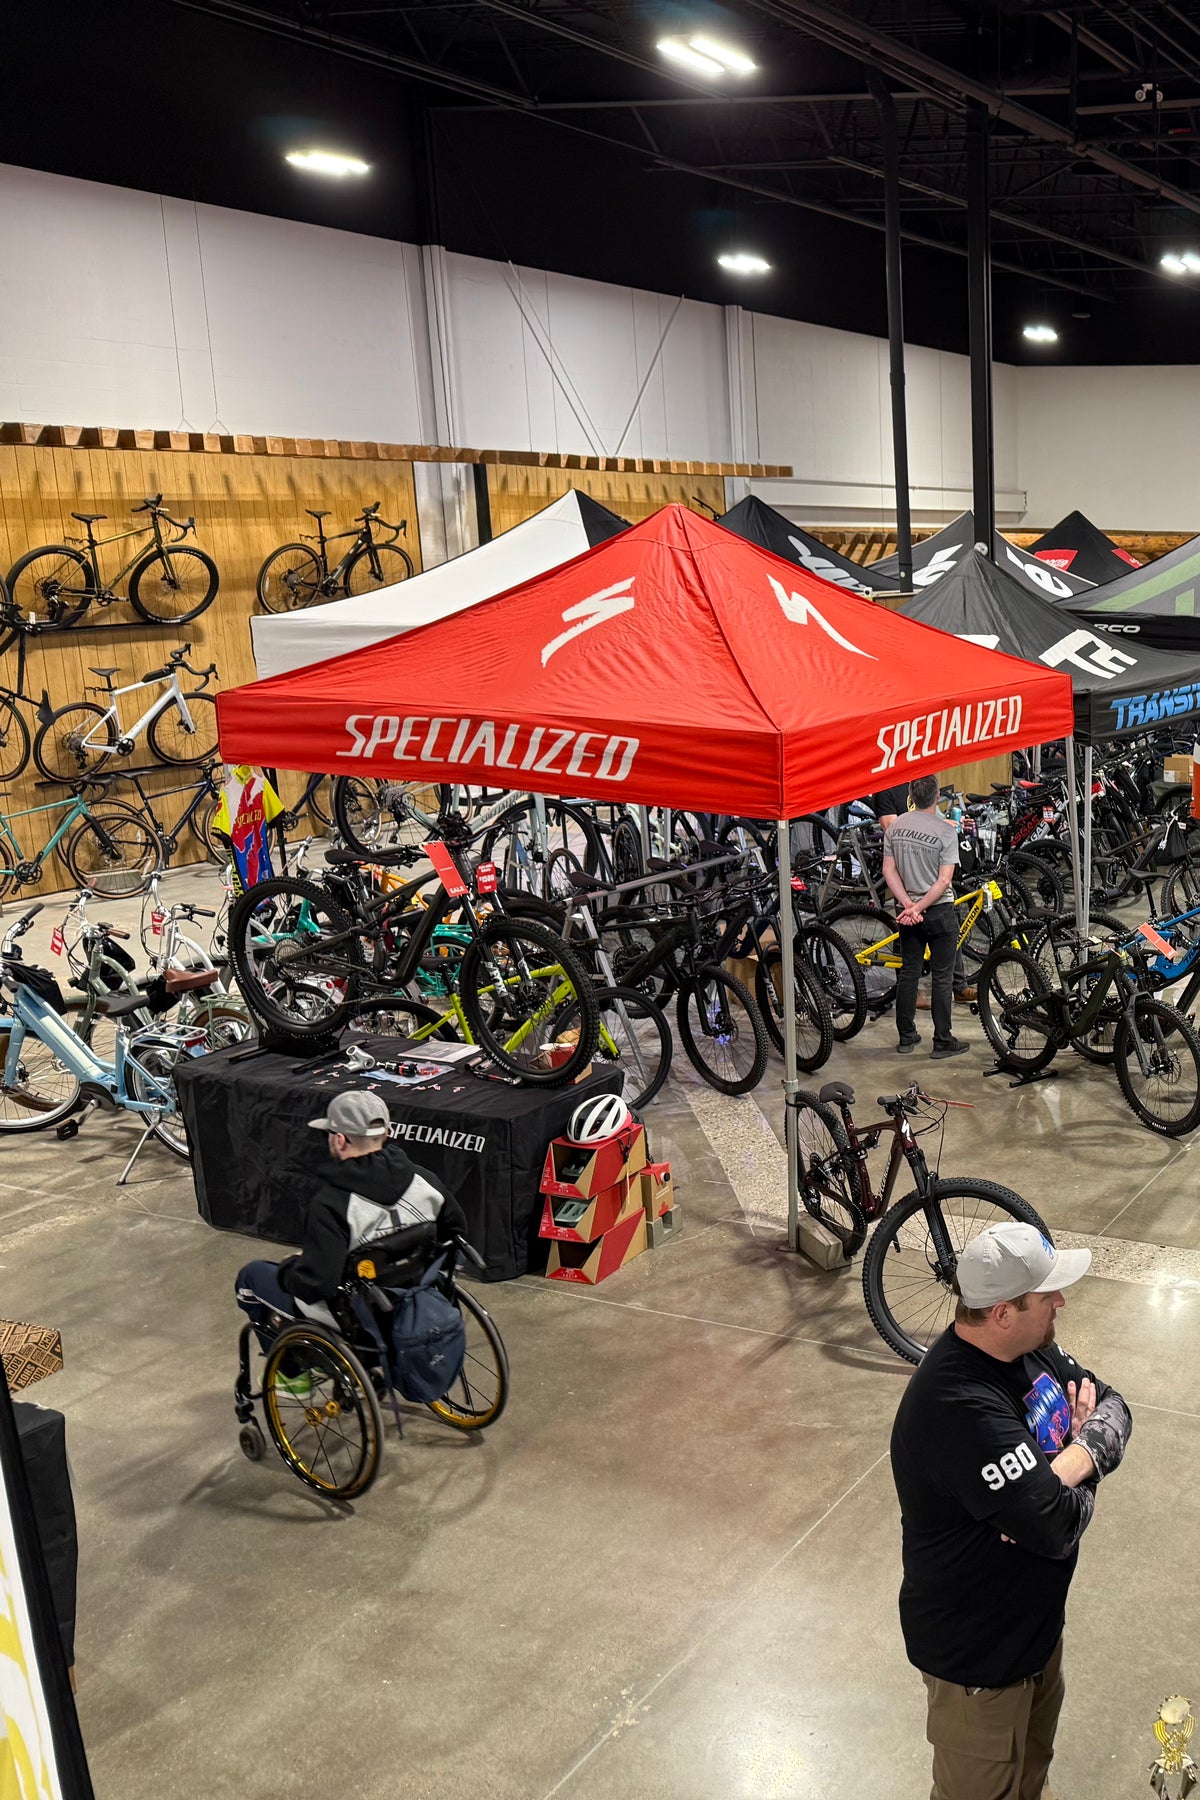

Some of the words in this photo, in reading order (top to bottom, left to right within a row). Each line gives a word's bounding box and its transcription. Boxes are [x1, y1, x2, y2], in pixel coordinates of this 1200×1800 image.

[336, 714, 640, 782] SPECIALIZED
[871, 695, 1022, 774] SPECIALIZED
[891, 828, 939, 845] SPECIALIZED
[387, 1121, 486, 1153] SPECIALIZED
[981, 1441, 1038, 1491] 980
